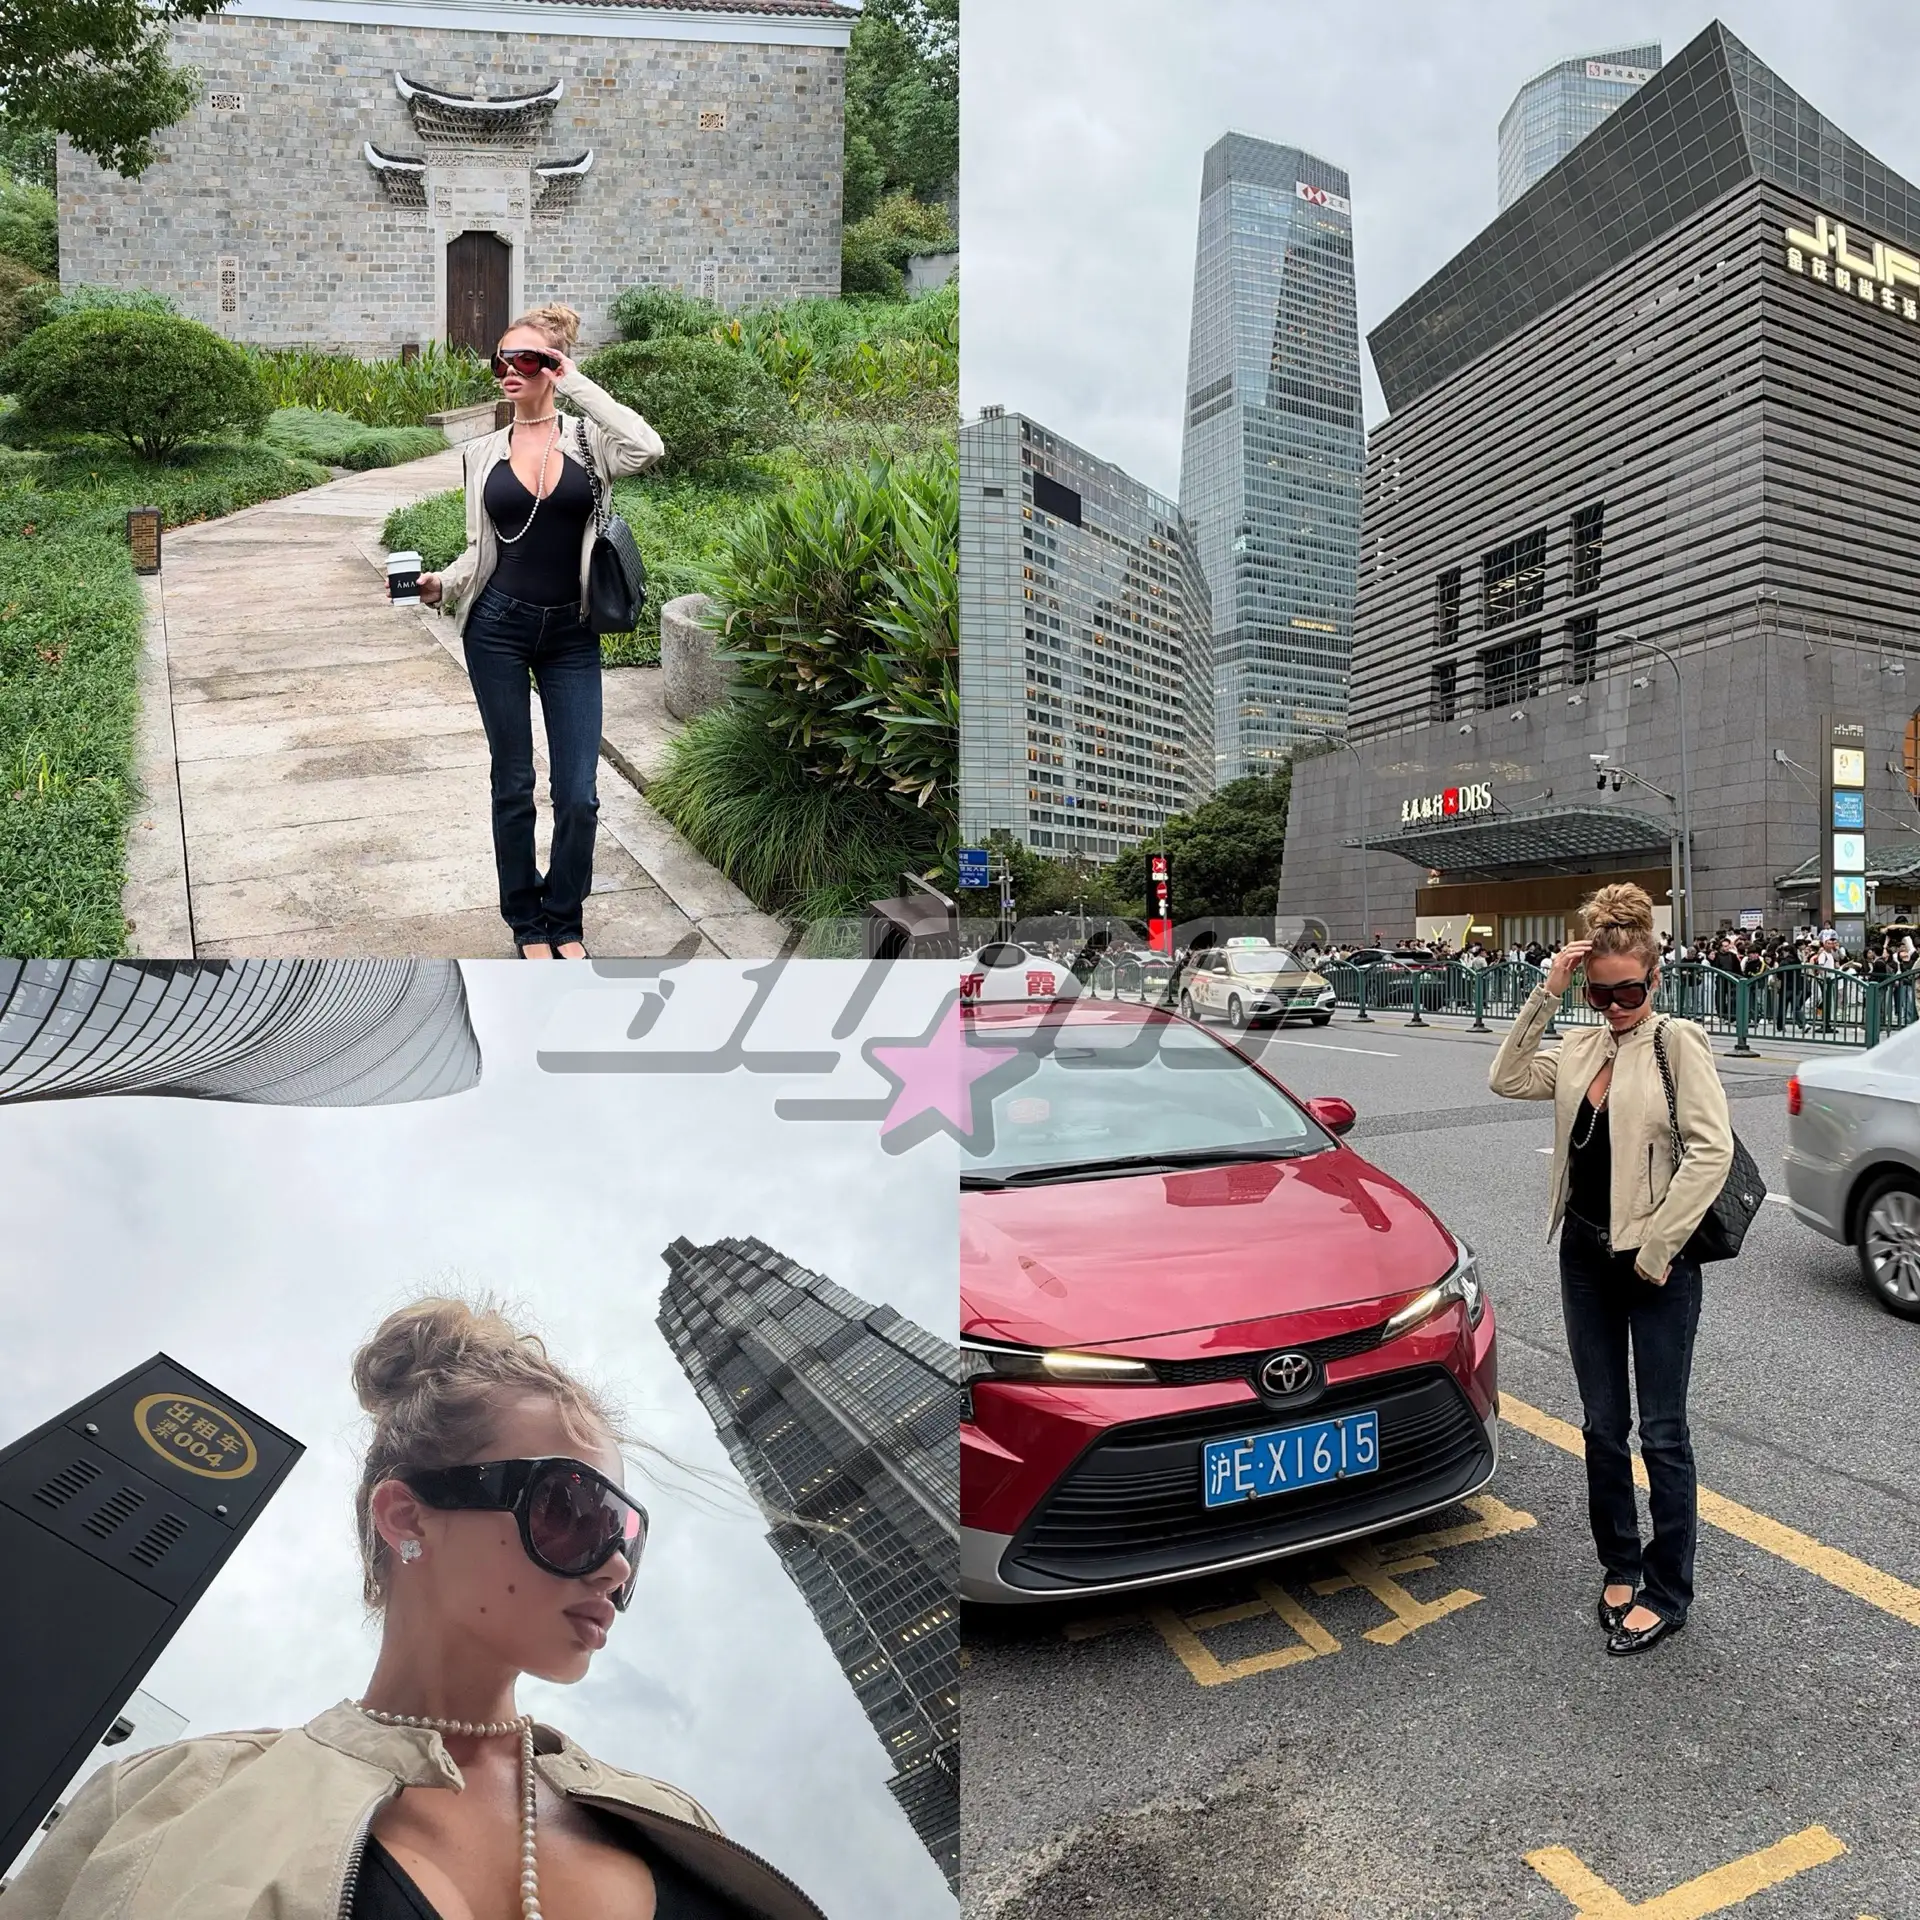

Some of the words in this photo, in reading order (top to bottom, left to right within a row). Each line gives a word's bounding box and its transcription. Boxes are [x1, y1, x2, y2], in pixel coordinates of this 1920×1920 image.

[1458, 782, 1492, 813] DBS
[166, 1402, 243, 1454] 出租车
